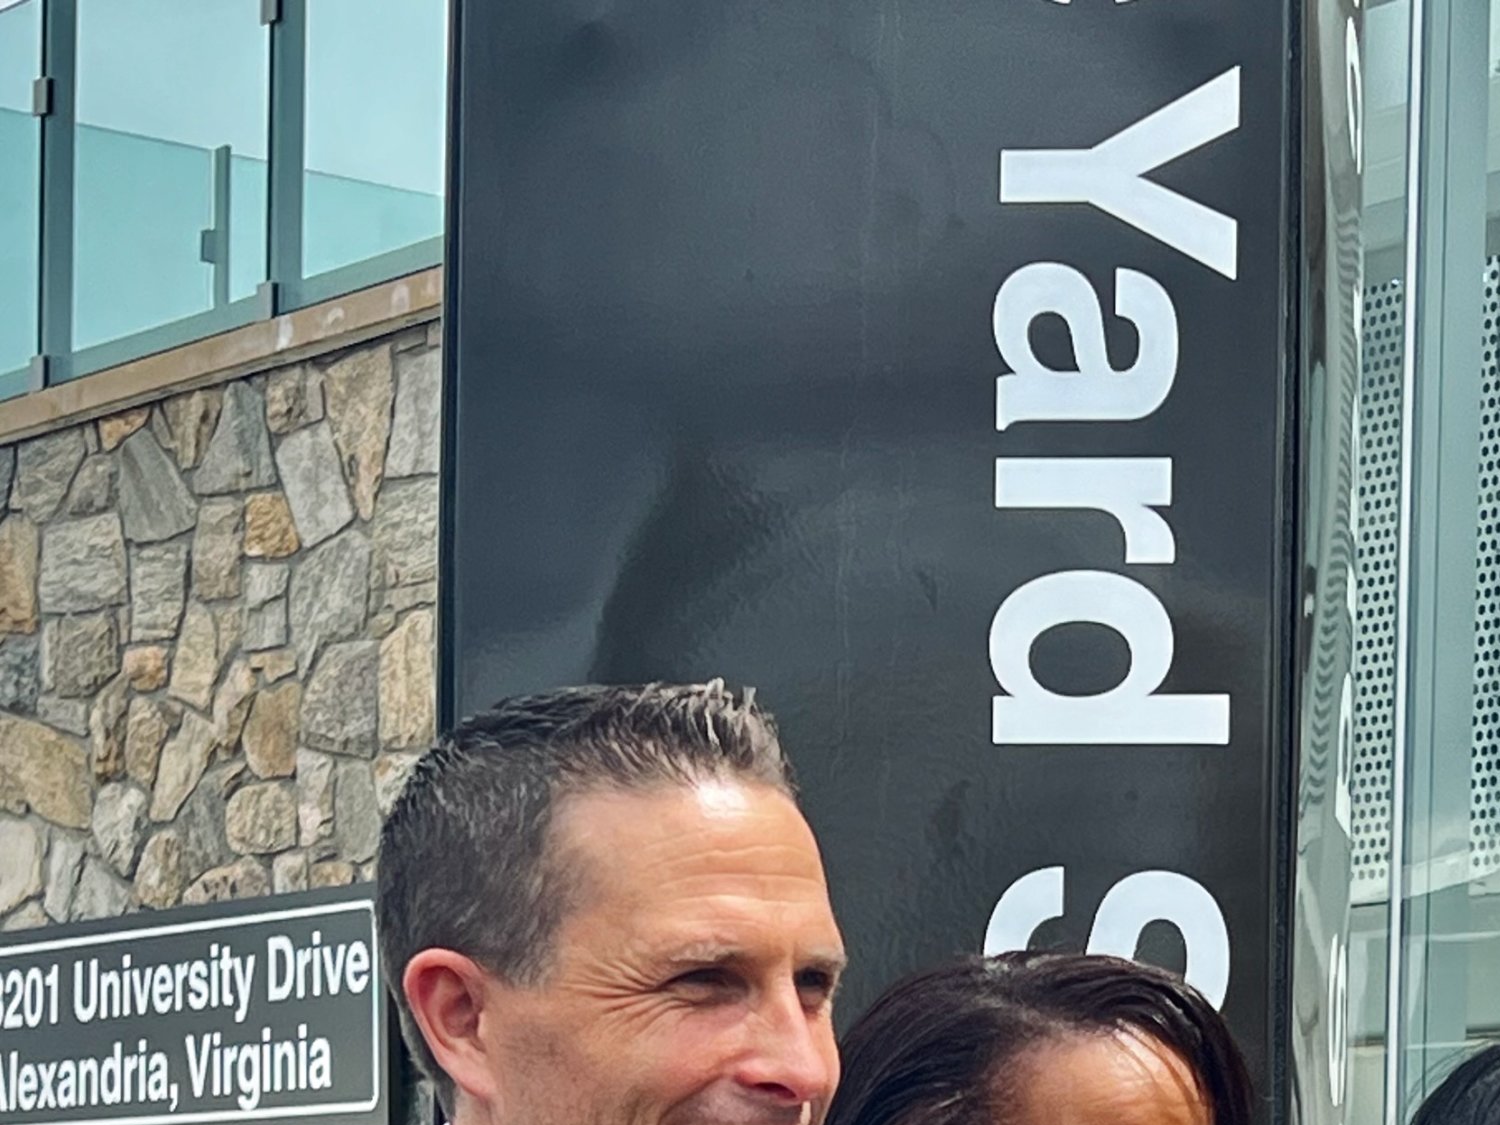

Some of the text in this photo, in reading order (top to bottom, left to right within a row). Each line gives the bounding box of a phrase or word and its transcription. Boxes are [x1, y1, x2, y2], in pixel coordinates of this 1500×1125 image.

[988, 65, 1241, 745] Yard
[0, 930, 370, 1030] 201 University Drive
[185, 1023, 332, 1110] Virginia
